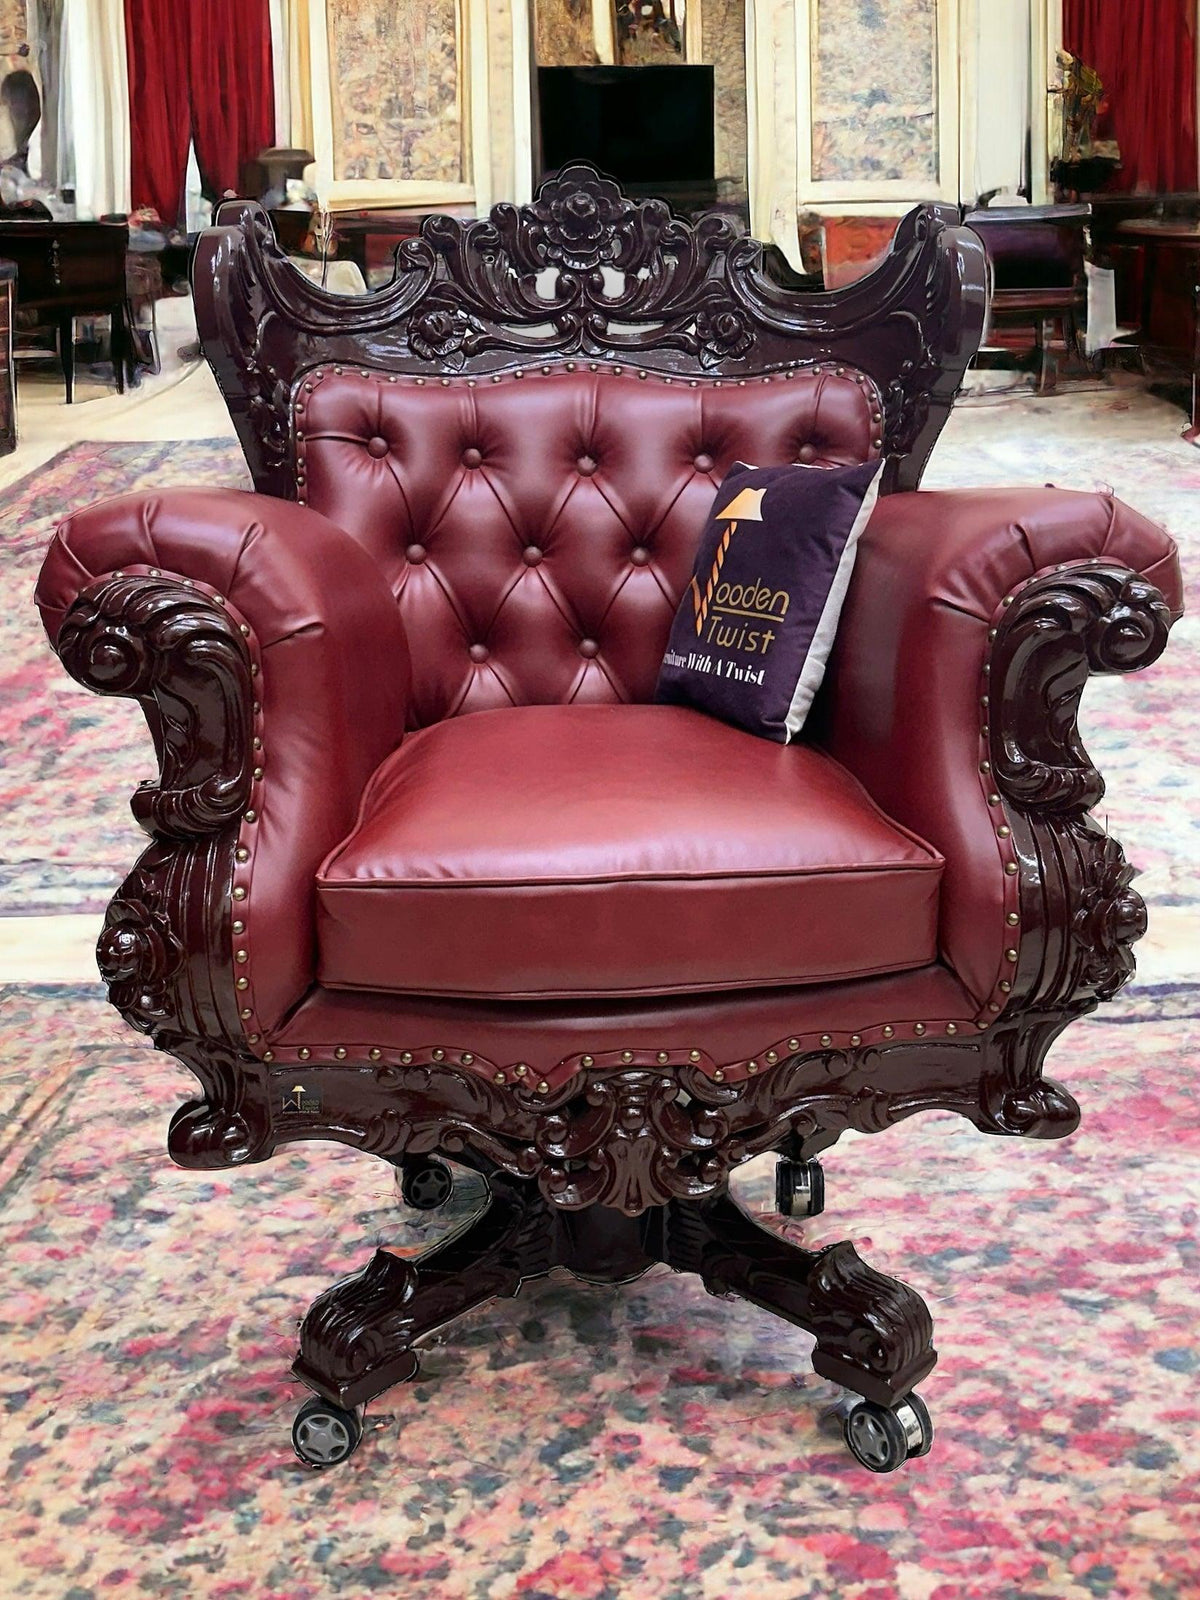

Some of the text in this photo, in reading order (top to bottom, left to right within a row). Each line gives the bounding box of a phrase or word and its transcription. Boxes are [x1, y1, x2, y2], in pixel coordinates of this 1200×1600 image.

[706, 615, 776, 655] Twist
[687, 652, 712, 674] With
[712, 658, 723, 676] A
[725, 660, 766, 686] Twist
